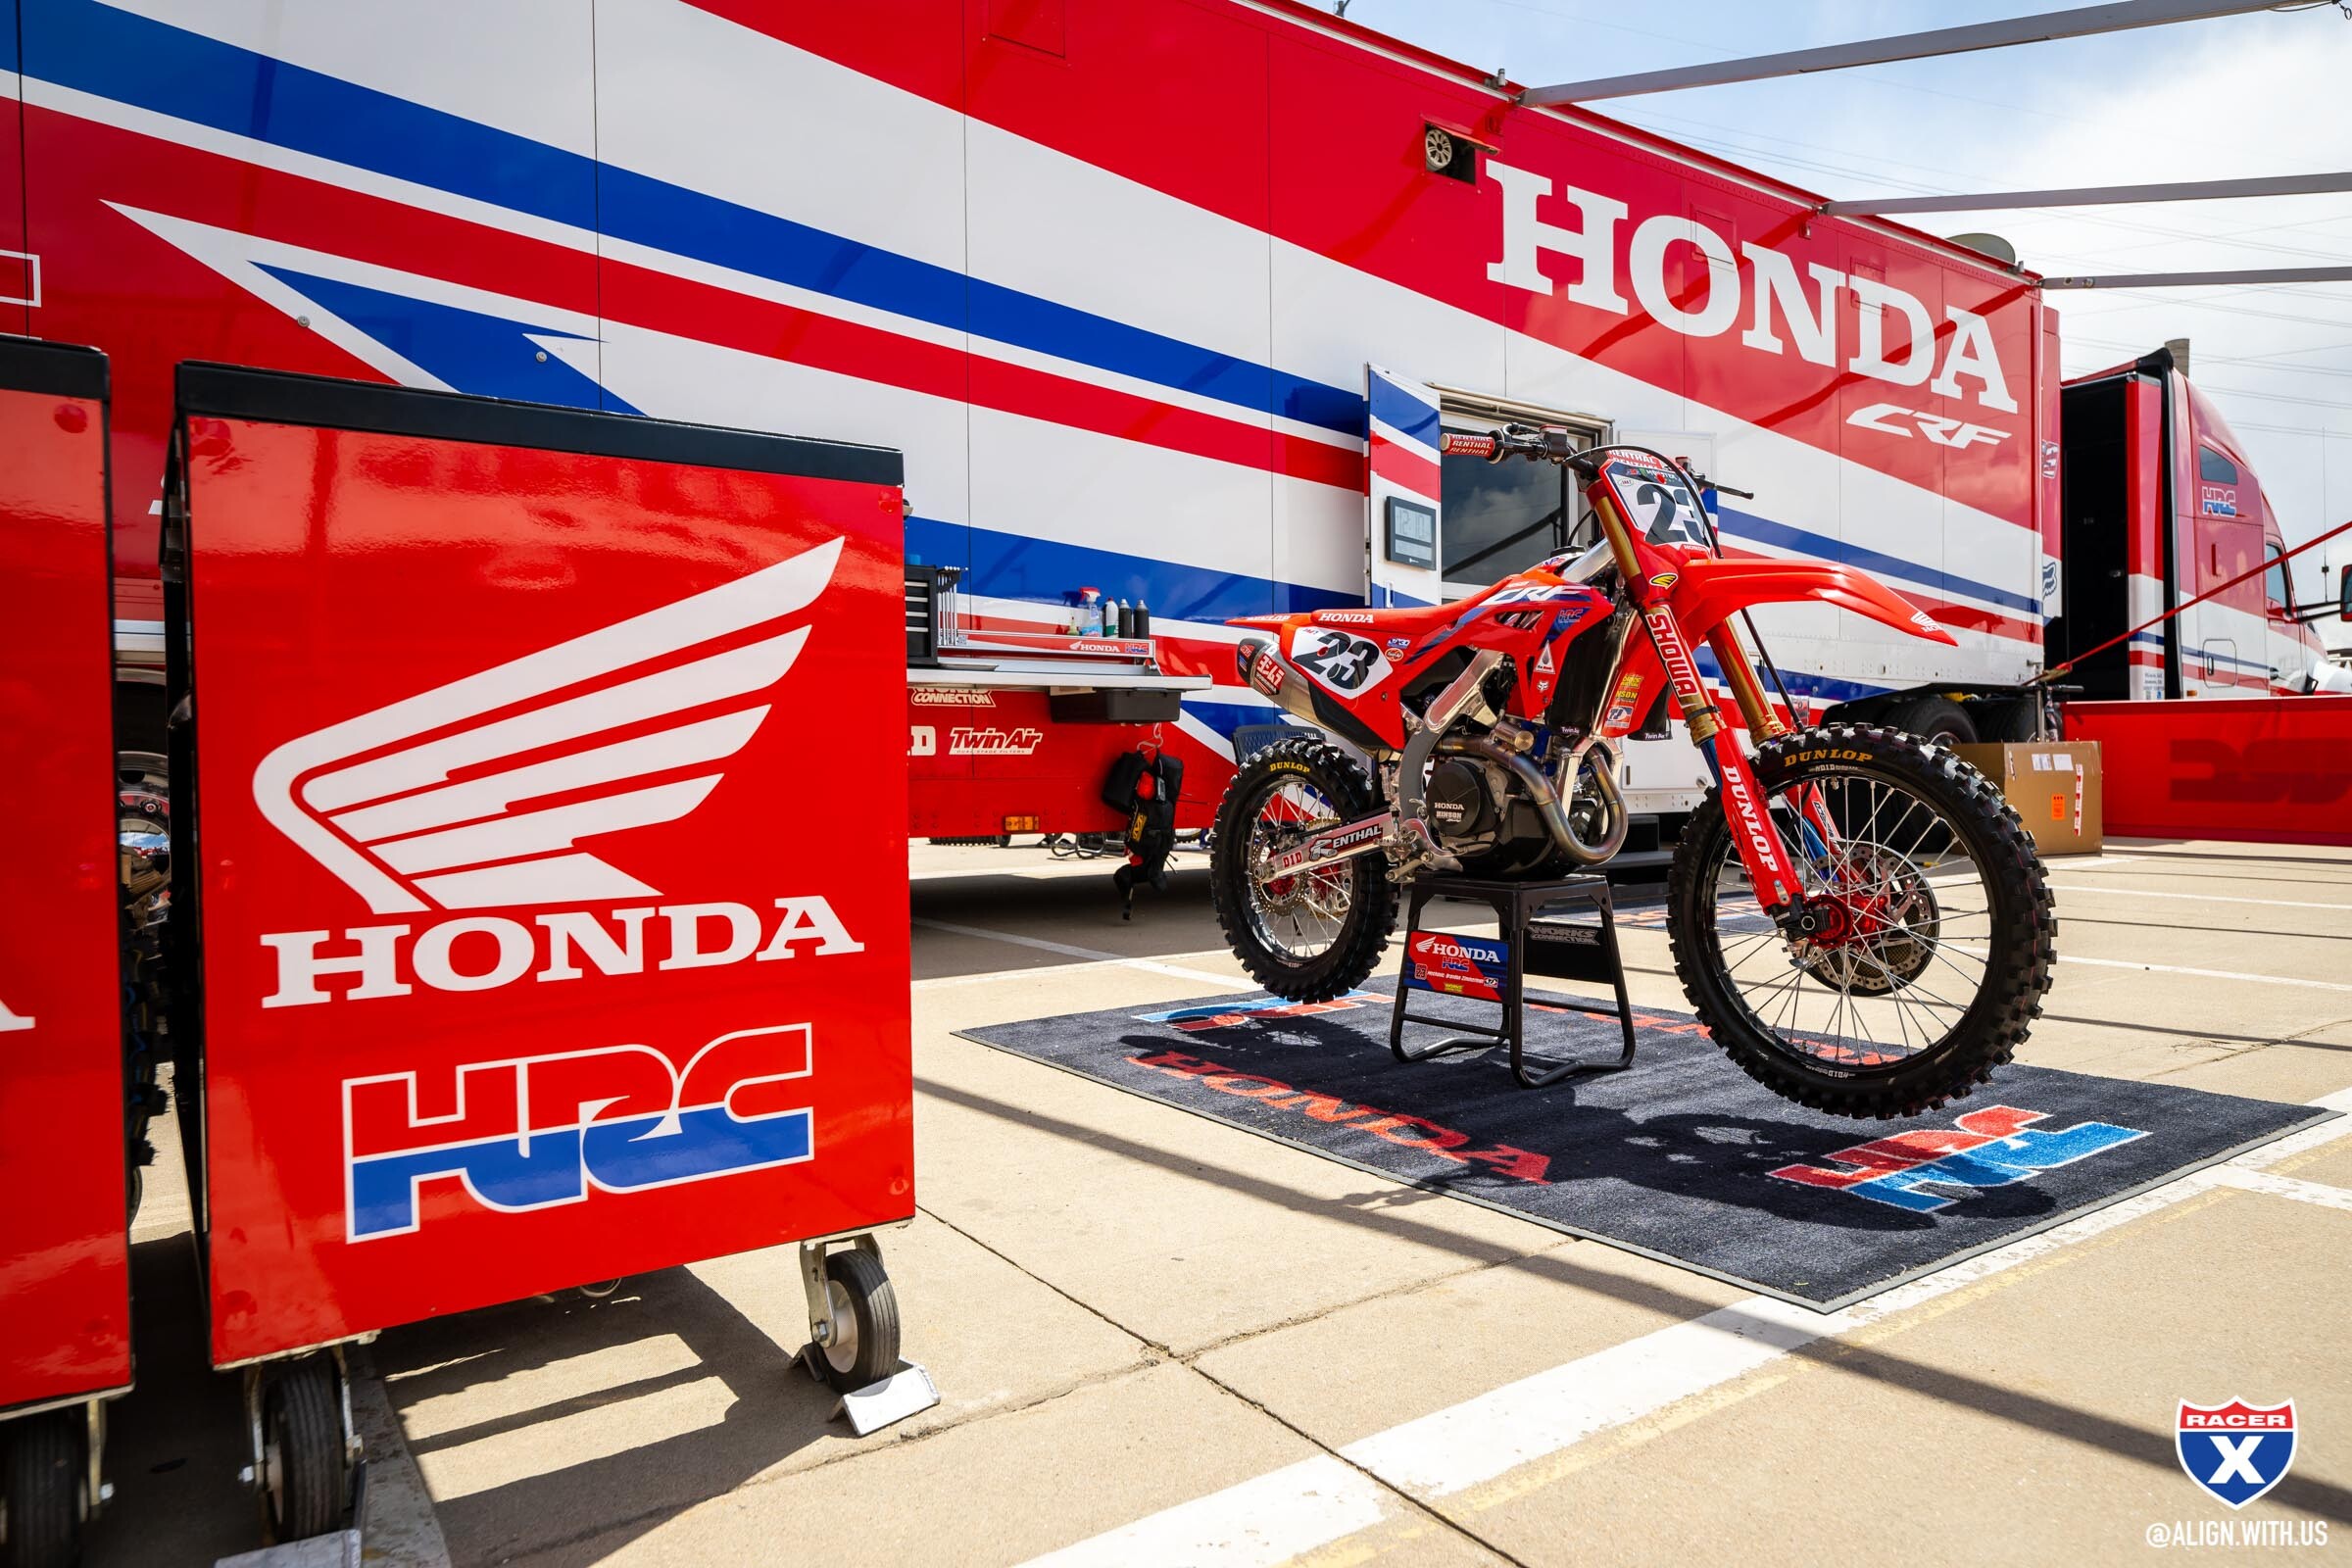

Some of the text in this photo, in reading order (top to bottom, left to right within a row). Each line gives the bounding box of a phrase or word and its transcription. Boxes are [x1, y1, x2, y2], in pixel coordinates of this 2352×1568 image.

[1486, 158, 2019, 415] HONDA
[1845, 403, 2013, 450] CRF
[2202, 486, 2237, 517] HRC
[1318, 612, 1374, 623] HONDA
[1559, 609, 1583, 623] HRC
[1080, 644, 1121, 653] HONDA
[1125, 643, 1149, 654] HRC
[1646, 612, 1699, 698] SHOWA
[1293, 631, 1379, 690] 23
[913, 693, 992, 705] CONNECTION
[1269, 761, 1310, 772] DUNLOP
[1784, 749, 1873, 767] DUNLOP
[1434, 802, 1465, 810] HONDA
[1723, 765, 1779, 871] DUNLOP
[1282, 852, 1301, 868] DID
[260, 895, 865, 1008] HONDA
[1432, 943, 1500, 963] HONDA
[1442, 956, 1471, 972] HRC
[1124, 1051, 1551, 1186] HONDA
[342, 1022, 814, 1245] HRC
[1766, 1104, 2151, 1213] HRC
